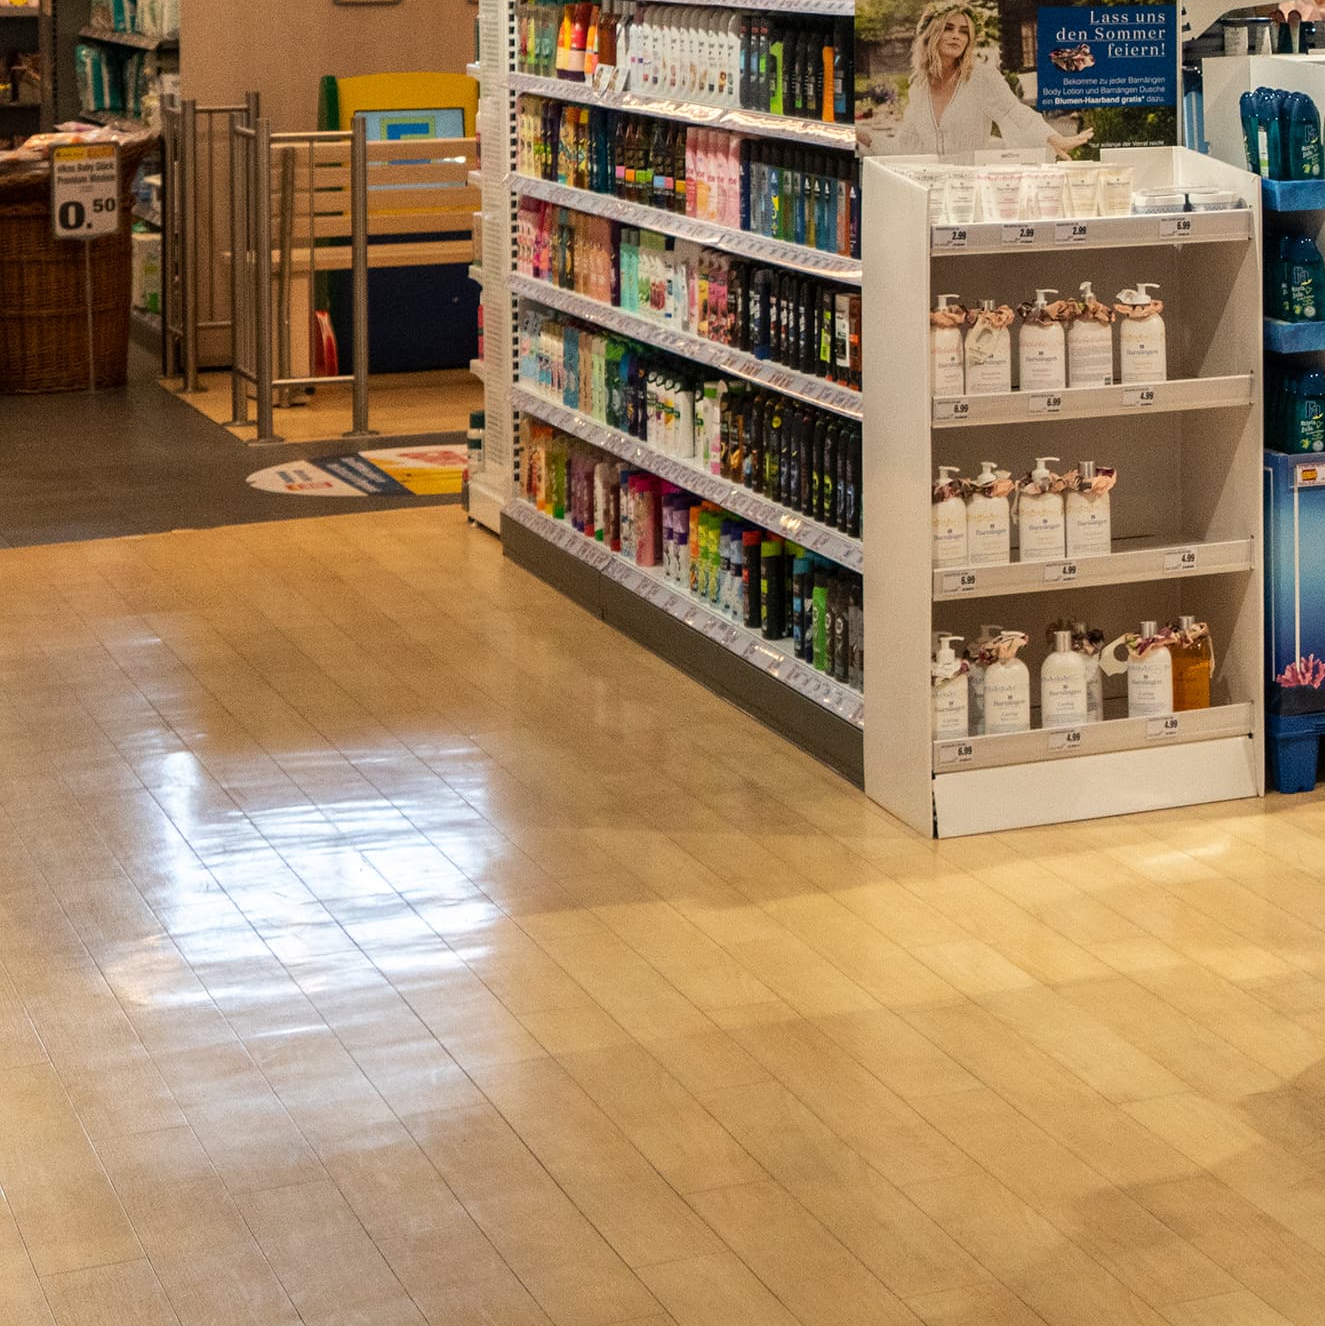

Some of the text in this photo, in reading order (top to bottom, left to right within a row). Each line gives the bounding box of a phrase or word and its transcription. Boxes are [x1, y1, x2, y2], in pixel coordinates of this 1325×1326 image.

[1089, 10, 1166, 24] Lass uns
[1055, 26, 1166, 41] den Sommer
[1107, 42, 1166, 58] feiern!
[1063, 77, 1098, 85] Bekomme
[1108, 77, 1127, 85] jeder
[1127, 75, 1166, 85] Barnängen
[1042, 85, 1166, 97] Body Lotion und Barnängen Dusche
[1054, 96, 1120, 105] Blumen-Haarband
[1072, 226, 1086, 236] 2.99
[1140, 391, 1154, 401] 4.99
